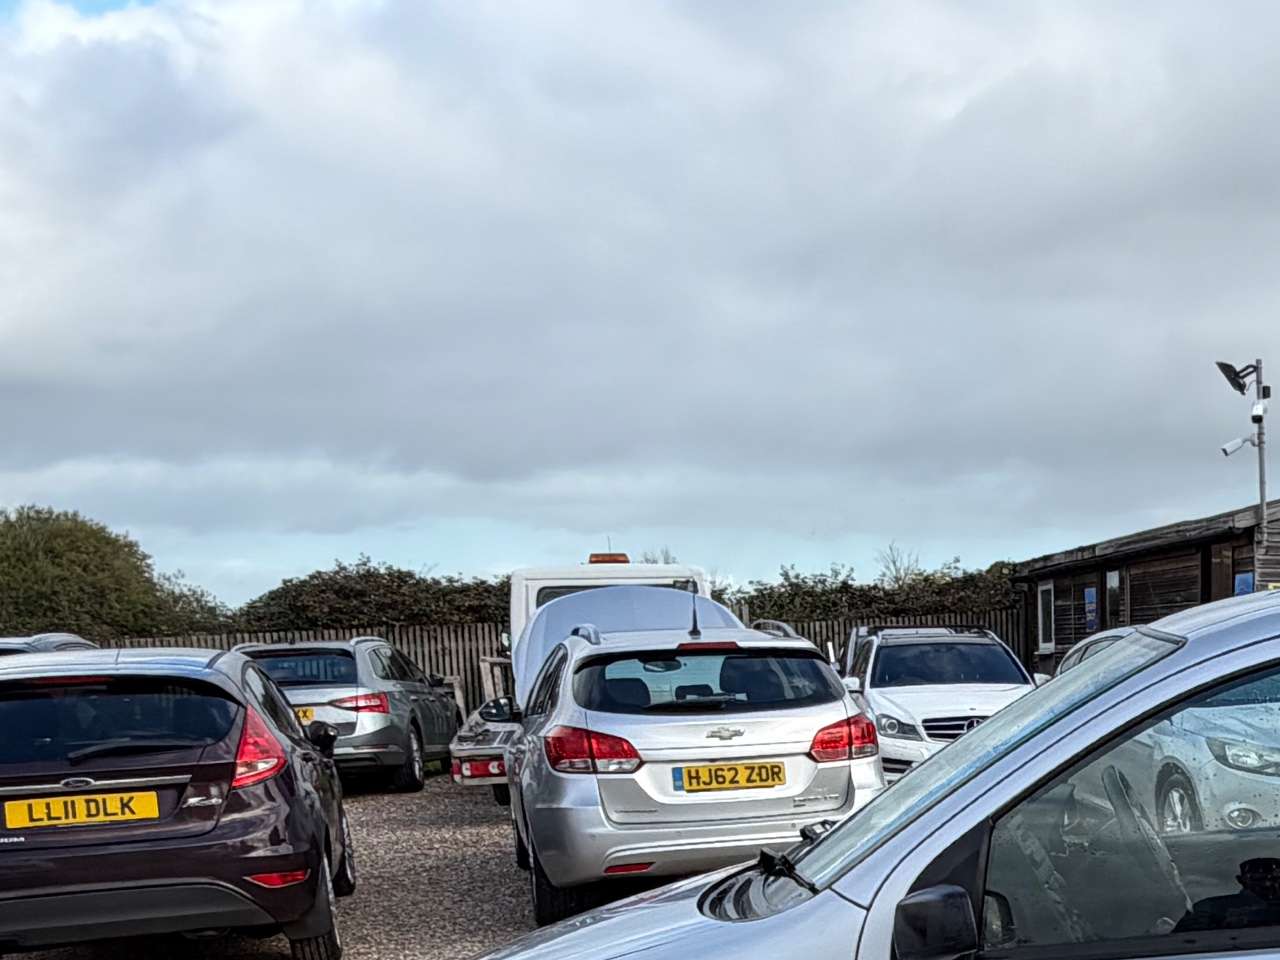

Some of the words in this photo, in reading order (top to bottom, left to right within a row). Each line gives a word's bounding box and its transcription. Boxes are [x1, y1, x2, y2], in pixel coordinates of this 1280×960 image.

[687, 767, 740, 787] HJ62
[744, 764, 783, 784] ZDR
[27, 799, 77, 822] LL11
[84, 796, 137, 818] DLK
